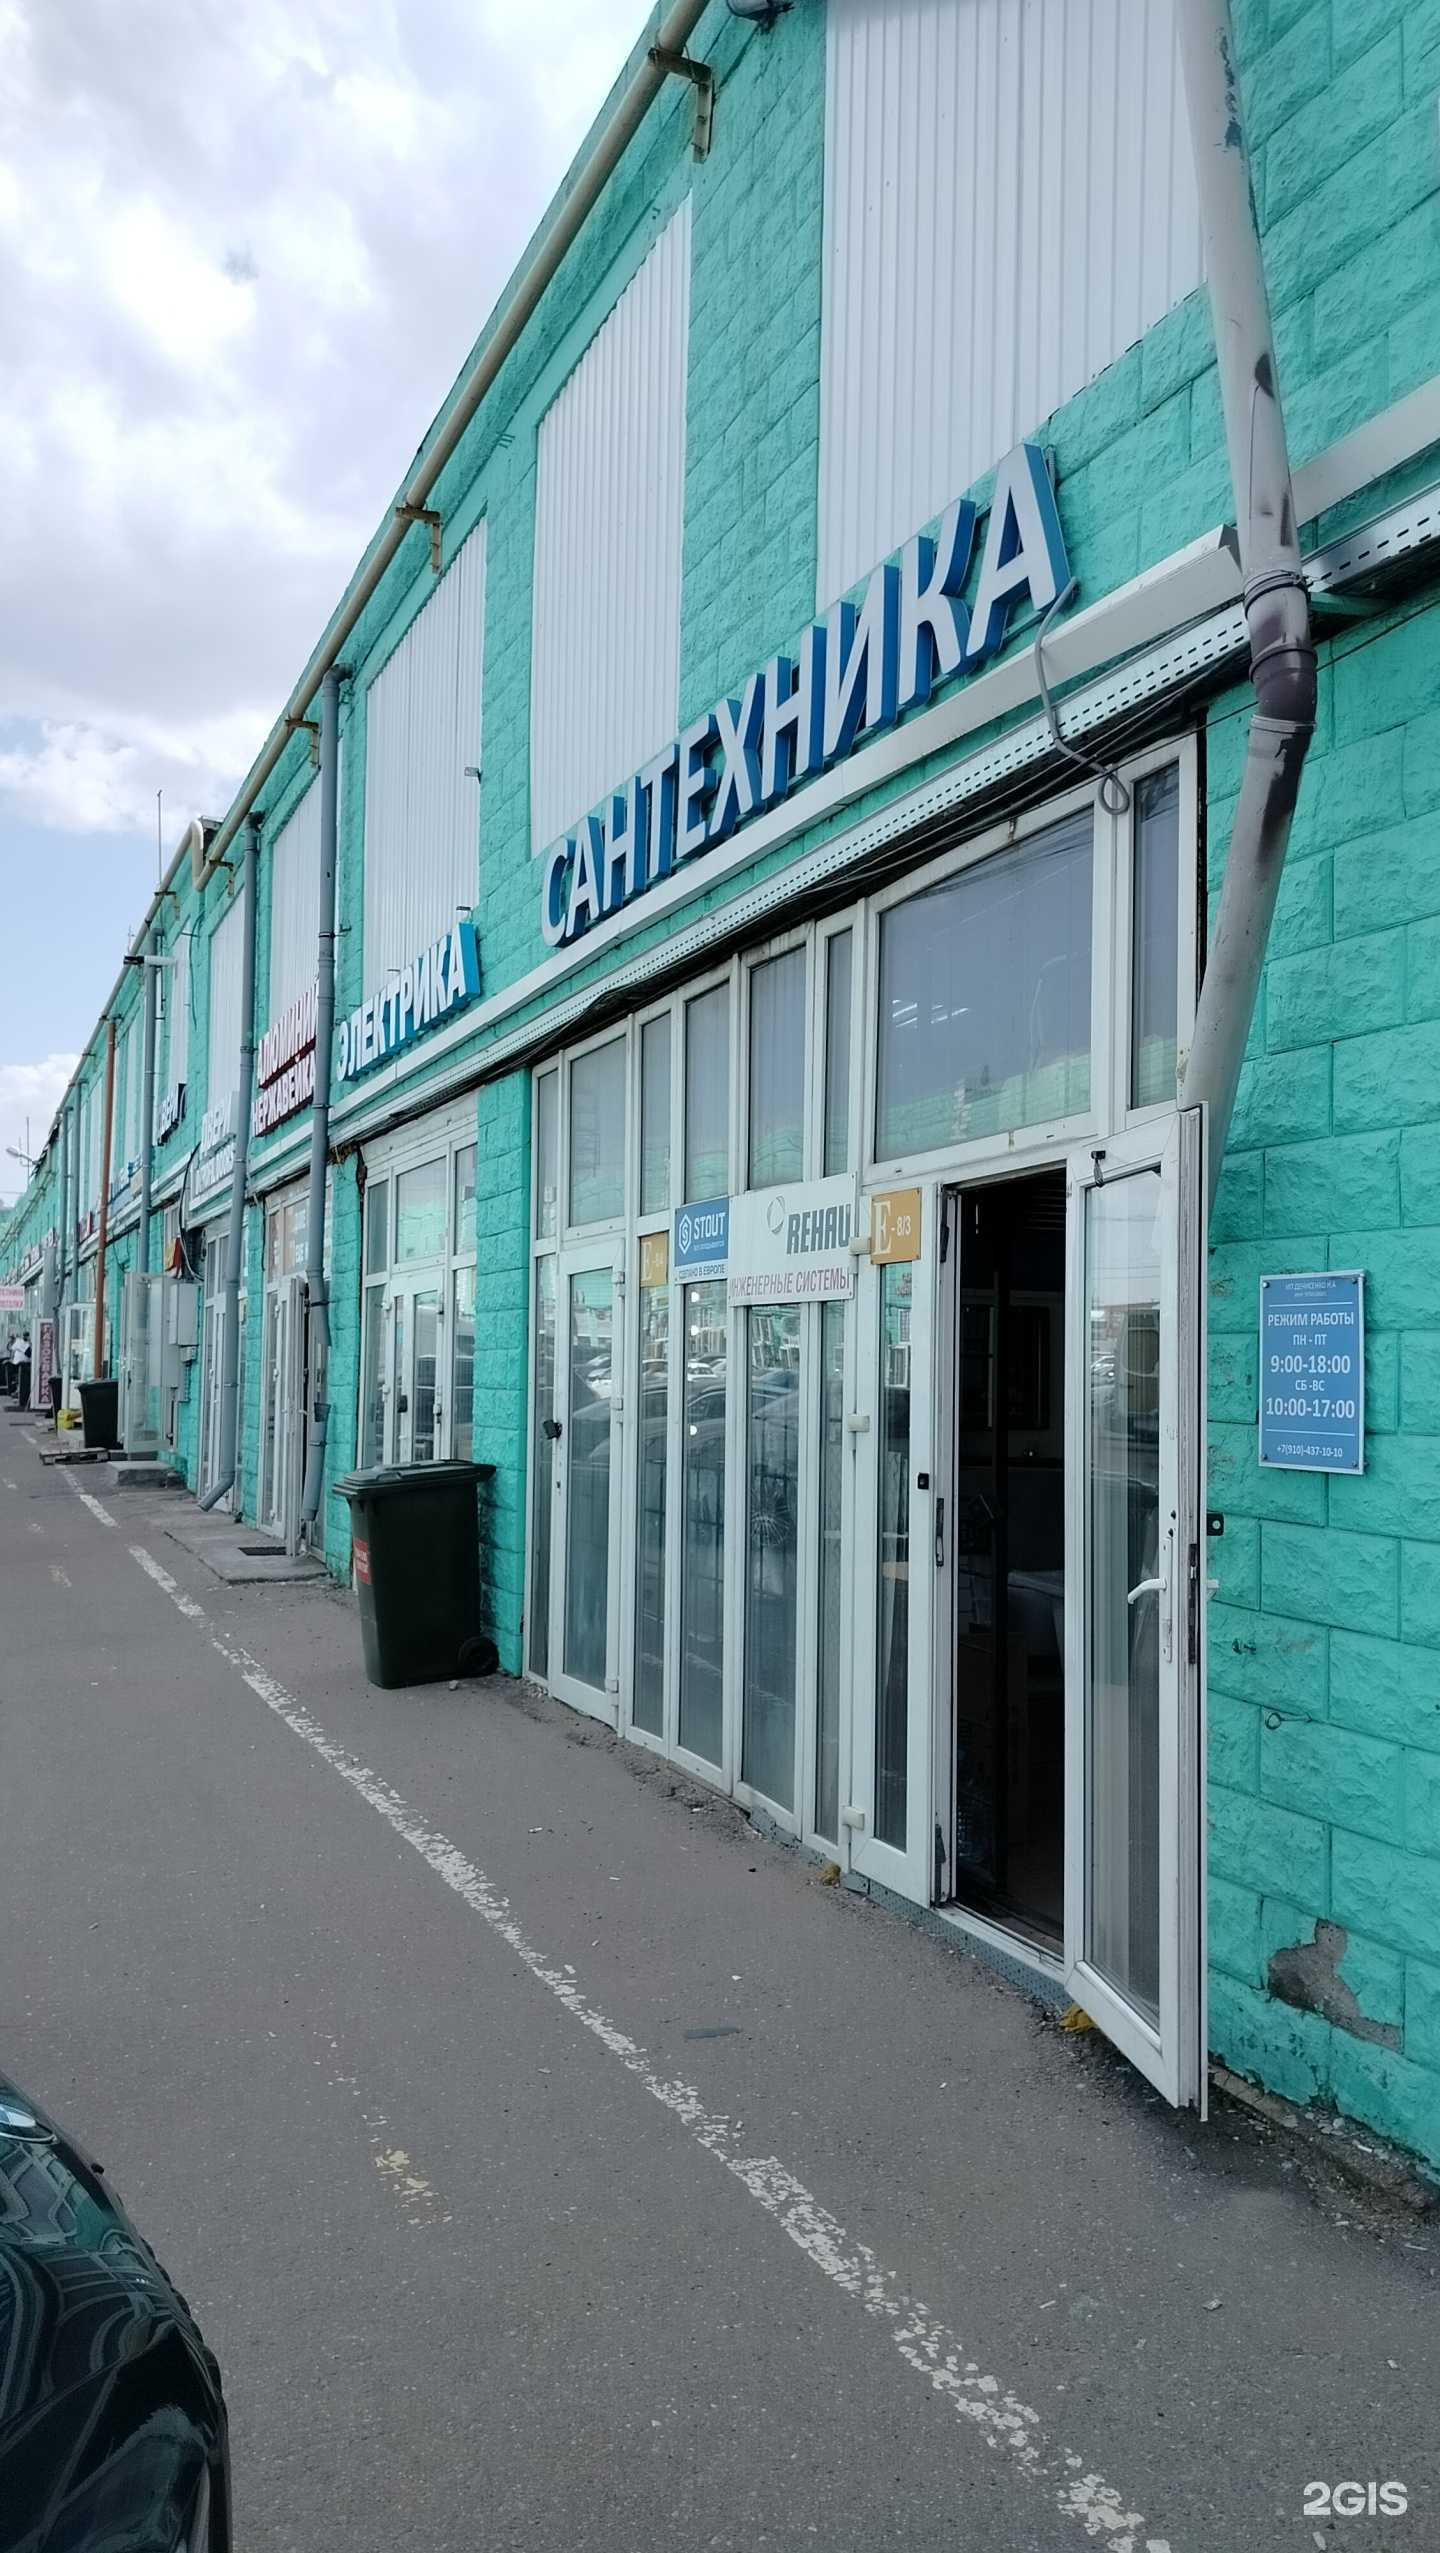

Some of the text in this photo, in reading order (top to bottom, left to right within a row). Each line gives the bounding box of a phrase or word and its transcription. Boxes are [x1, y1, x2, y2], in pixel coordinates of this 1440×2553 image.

[542, 443, 1069, 947] САНТЕХНИКА
[337, 922, 481, 1081] ЭЛЕКТРИКА
[694, 1212, 726, 1240] STOUT
[786, 1203, 851, 1254] REHAU
[729, 1267, 850, 1297] ИНЖЕНЕРНЫЕ СИСТЕМЫ
[1268, 1312, 1354, 1327] РЕЖИМ РАБОТЫ
[1293, 1334, 1307, 1345] ПН
[1314, 1334, 1328, 1345] ПТ
[40, 1324, 52, 1403] ГАЗОСВАРКА
[1270, 1355, 1351, 1374] 9:00-18:00
[1266, 1397, 1355, 1419] 10:00-17:00
